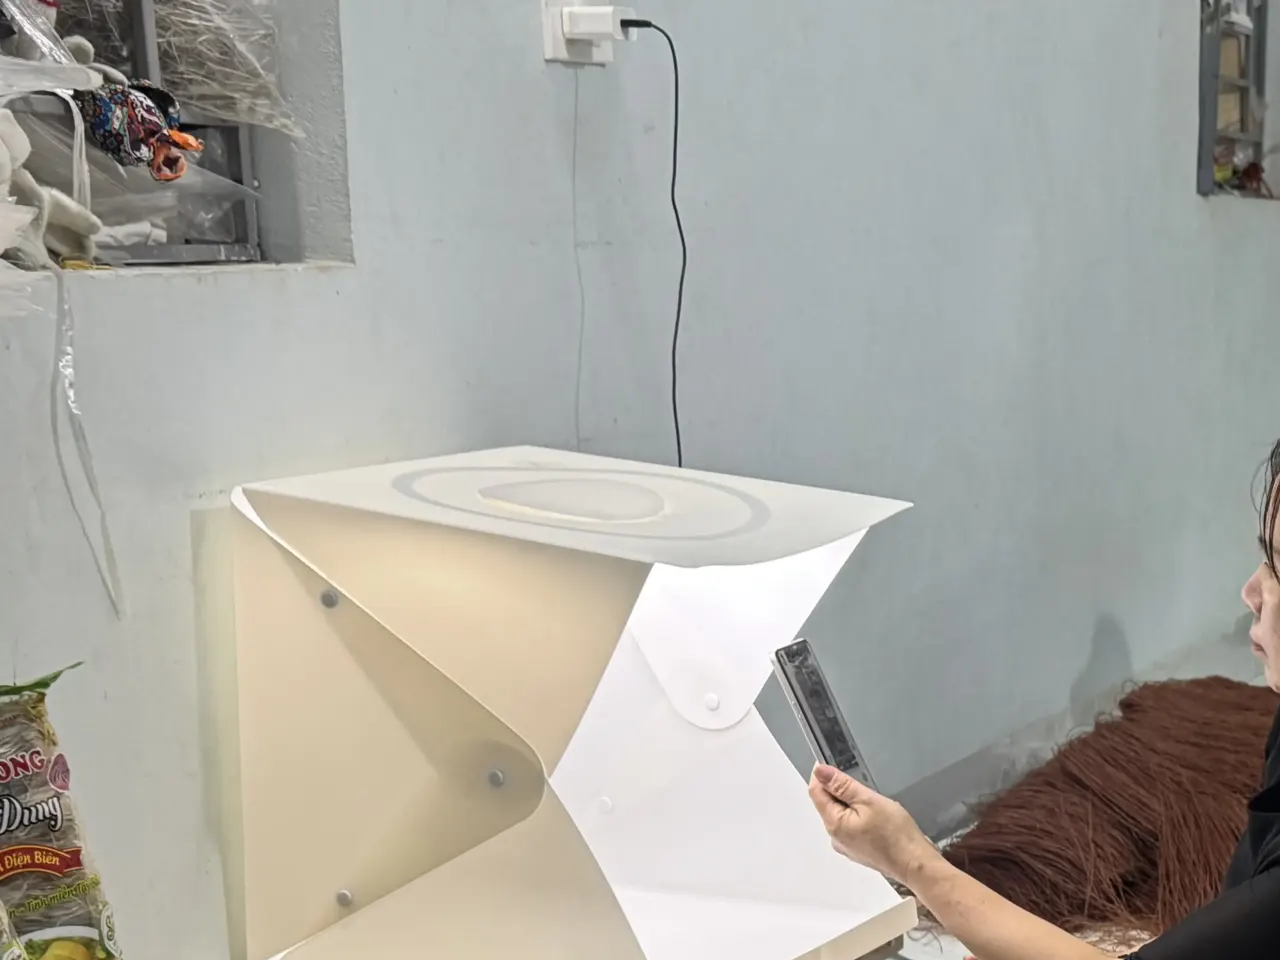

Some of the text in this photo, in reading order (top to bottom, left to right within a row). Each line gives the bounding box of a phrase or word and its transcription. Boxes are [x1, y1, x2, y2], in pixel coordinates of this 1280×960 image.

[0, 749, 46, 783] ONG
[0, 795, 63, 834] Dung
[4, 851, 60, 869] Điện Biên
